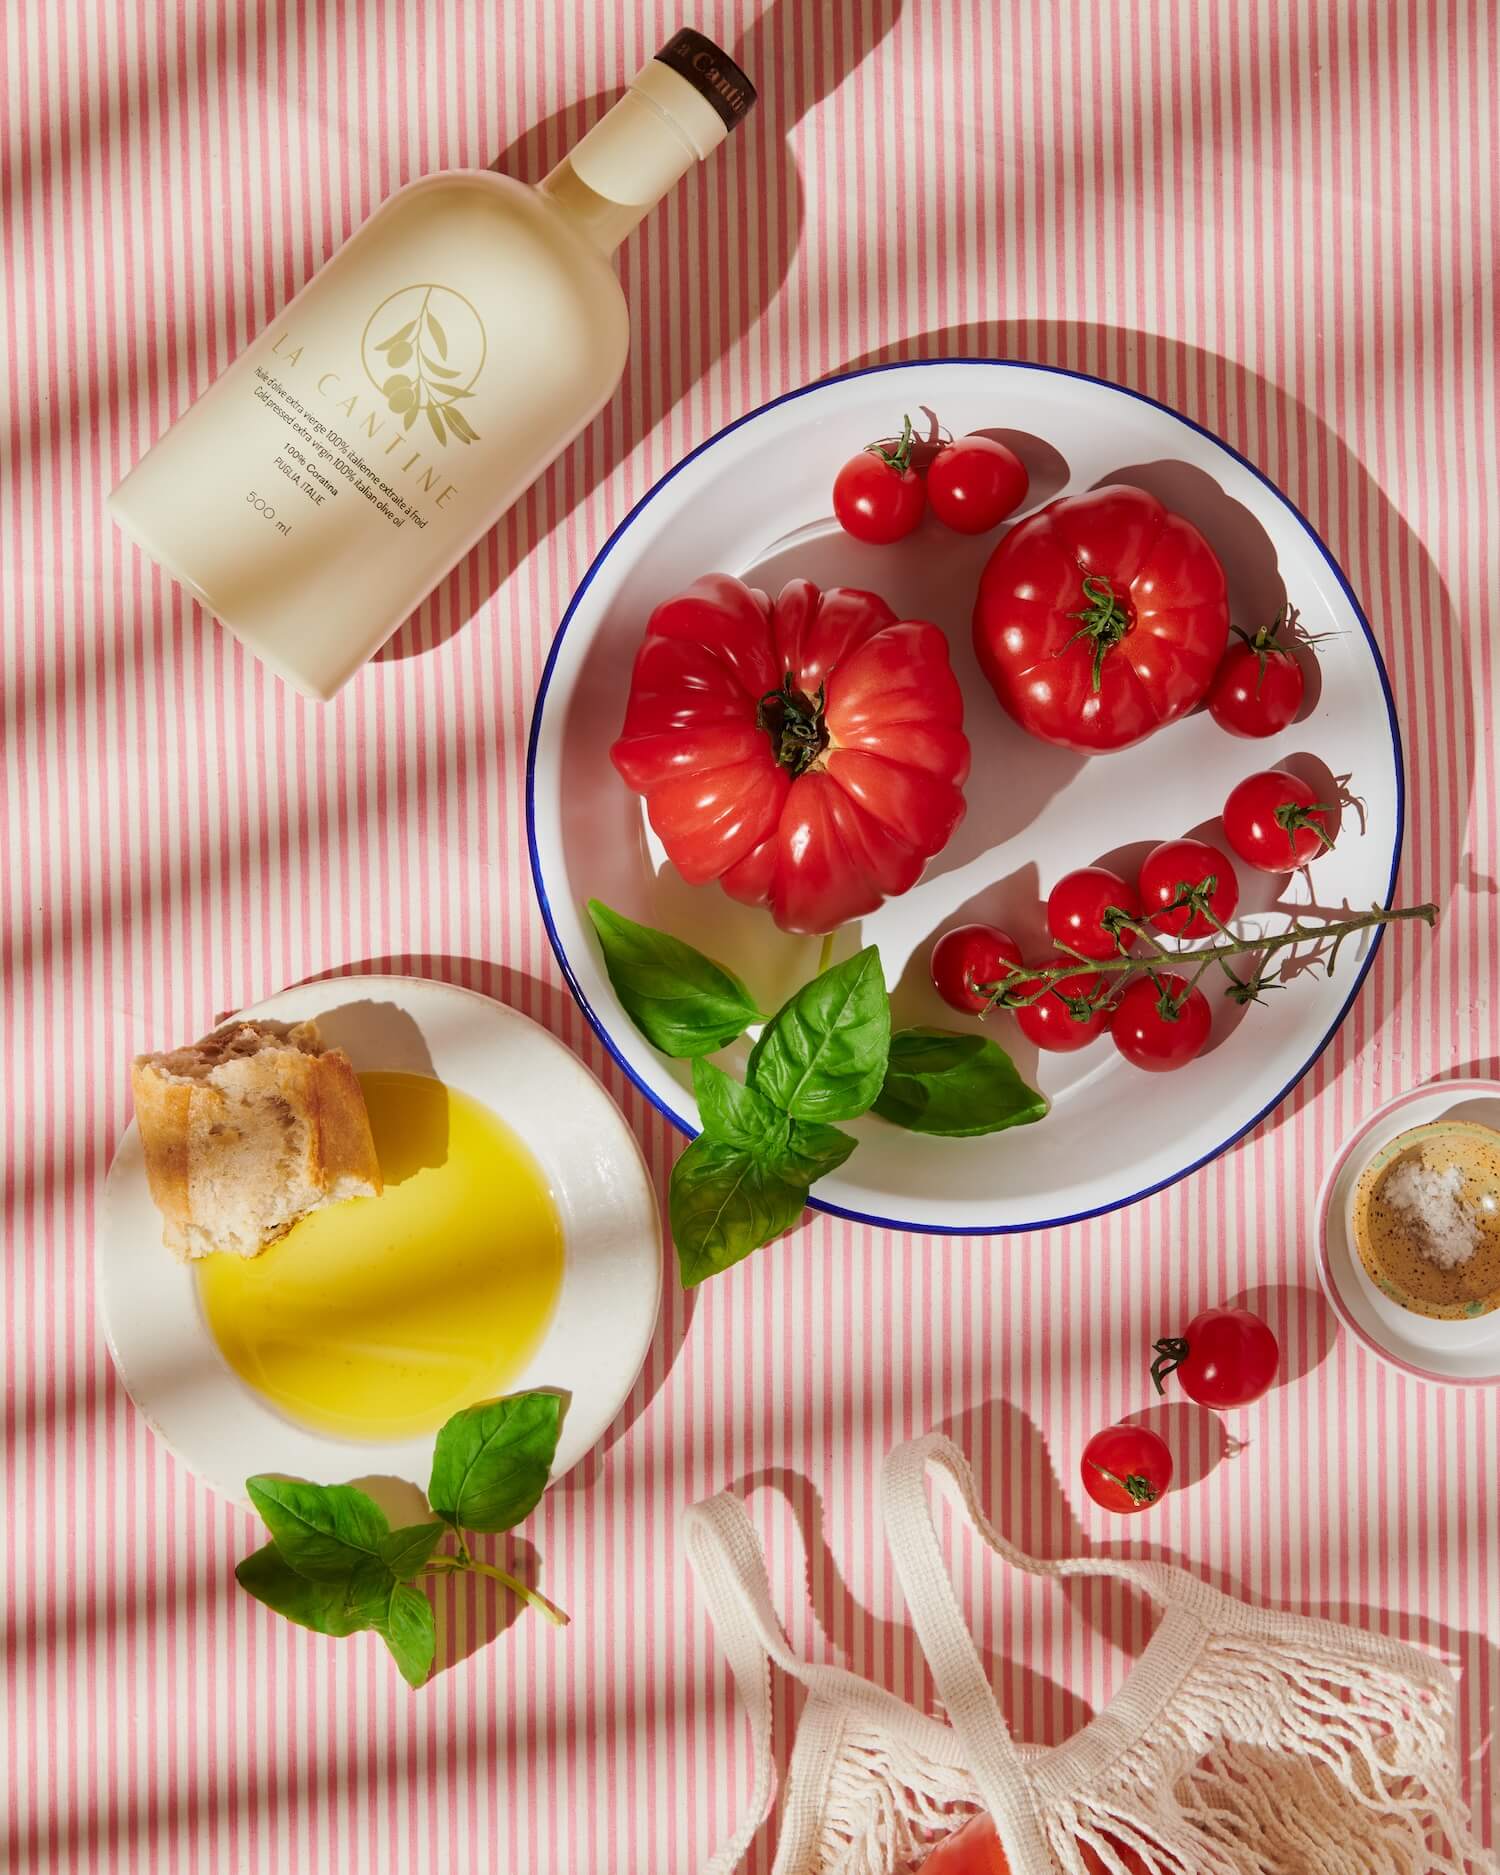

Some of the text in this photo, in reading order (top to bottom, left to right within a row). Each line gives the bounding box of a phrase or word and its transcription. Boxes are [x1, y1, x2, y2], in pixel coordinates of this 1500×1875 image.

[253, 385, 405, 528] Cold pressed extra virgin 100% italian olive oil
[271, 332, 459, 509] LA CANTINE
[285, 395, 304, 414] extra
[303, 411, 327, 434] vierge
[325, 430, 350, 455] 100%
[346, 451, 380, 485] italienne
[379, 482, 407, 510] extraite
[404, 505, 411, 515] à
[409, 509, 429, 529] froid
[246, 490, 292, 536] 500 ml
[284, 443, 338, 496] 100% Coratina
[300, 481, 326, 506] ITALIE
